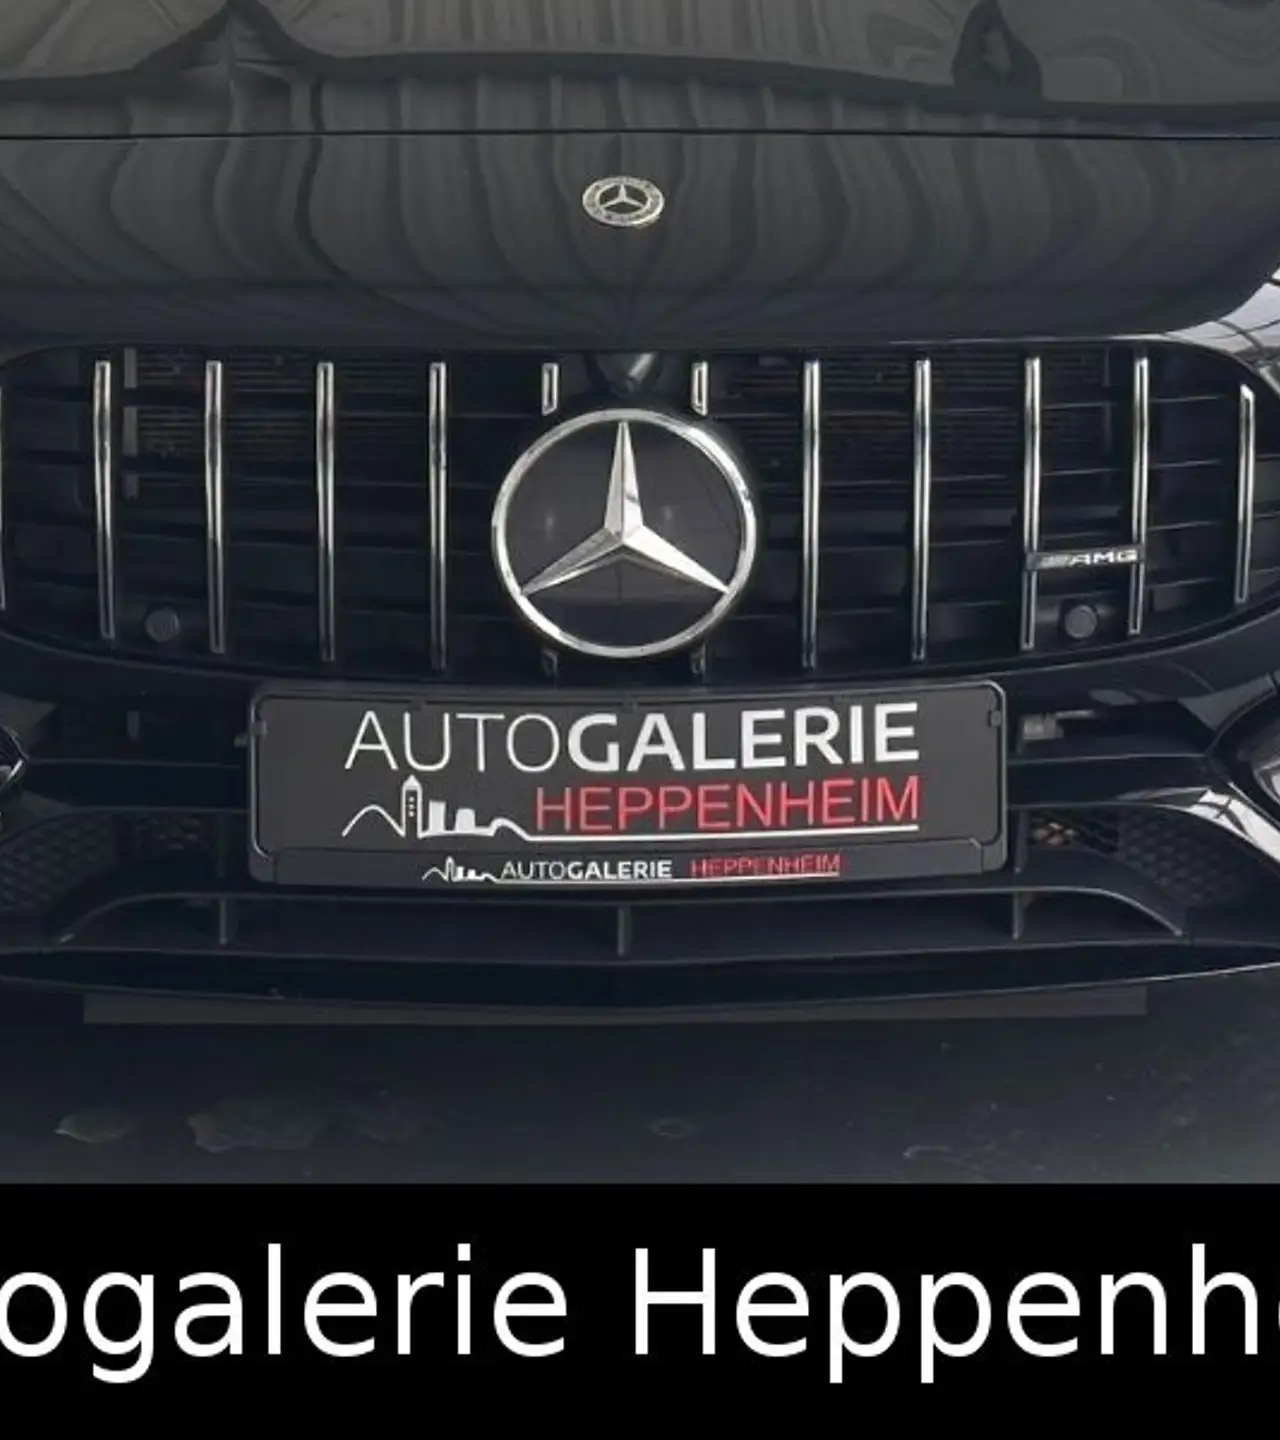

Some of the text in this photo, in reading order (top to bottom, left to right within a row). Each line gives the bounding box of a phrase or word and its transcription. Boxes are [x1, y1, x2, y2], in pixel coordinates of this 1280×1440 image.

[1068, 548, 1138, 566] AMG
[344, 701, 920, 772] AUTOGALERIE
[535, 774, 920, 833] HEPPENHEIM
[500, 853, 841, 881] AUTOGALERIE HEPPENHEIM
